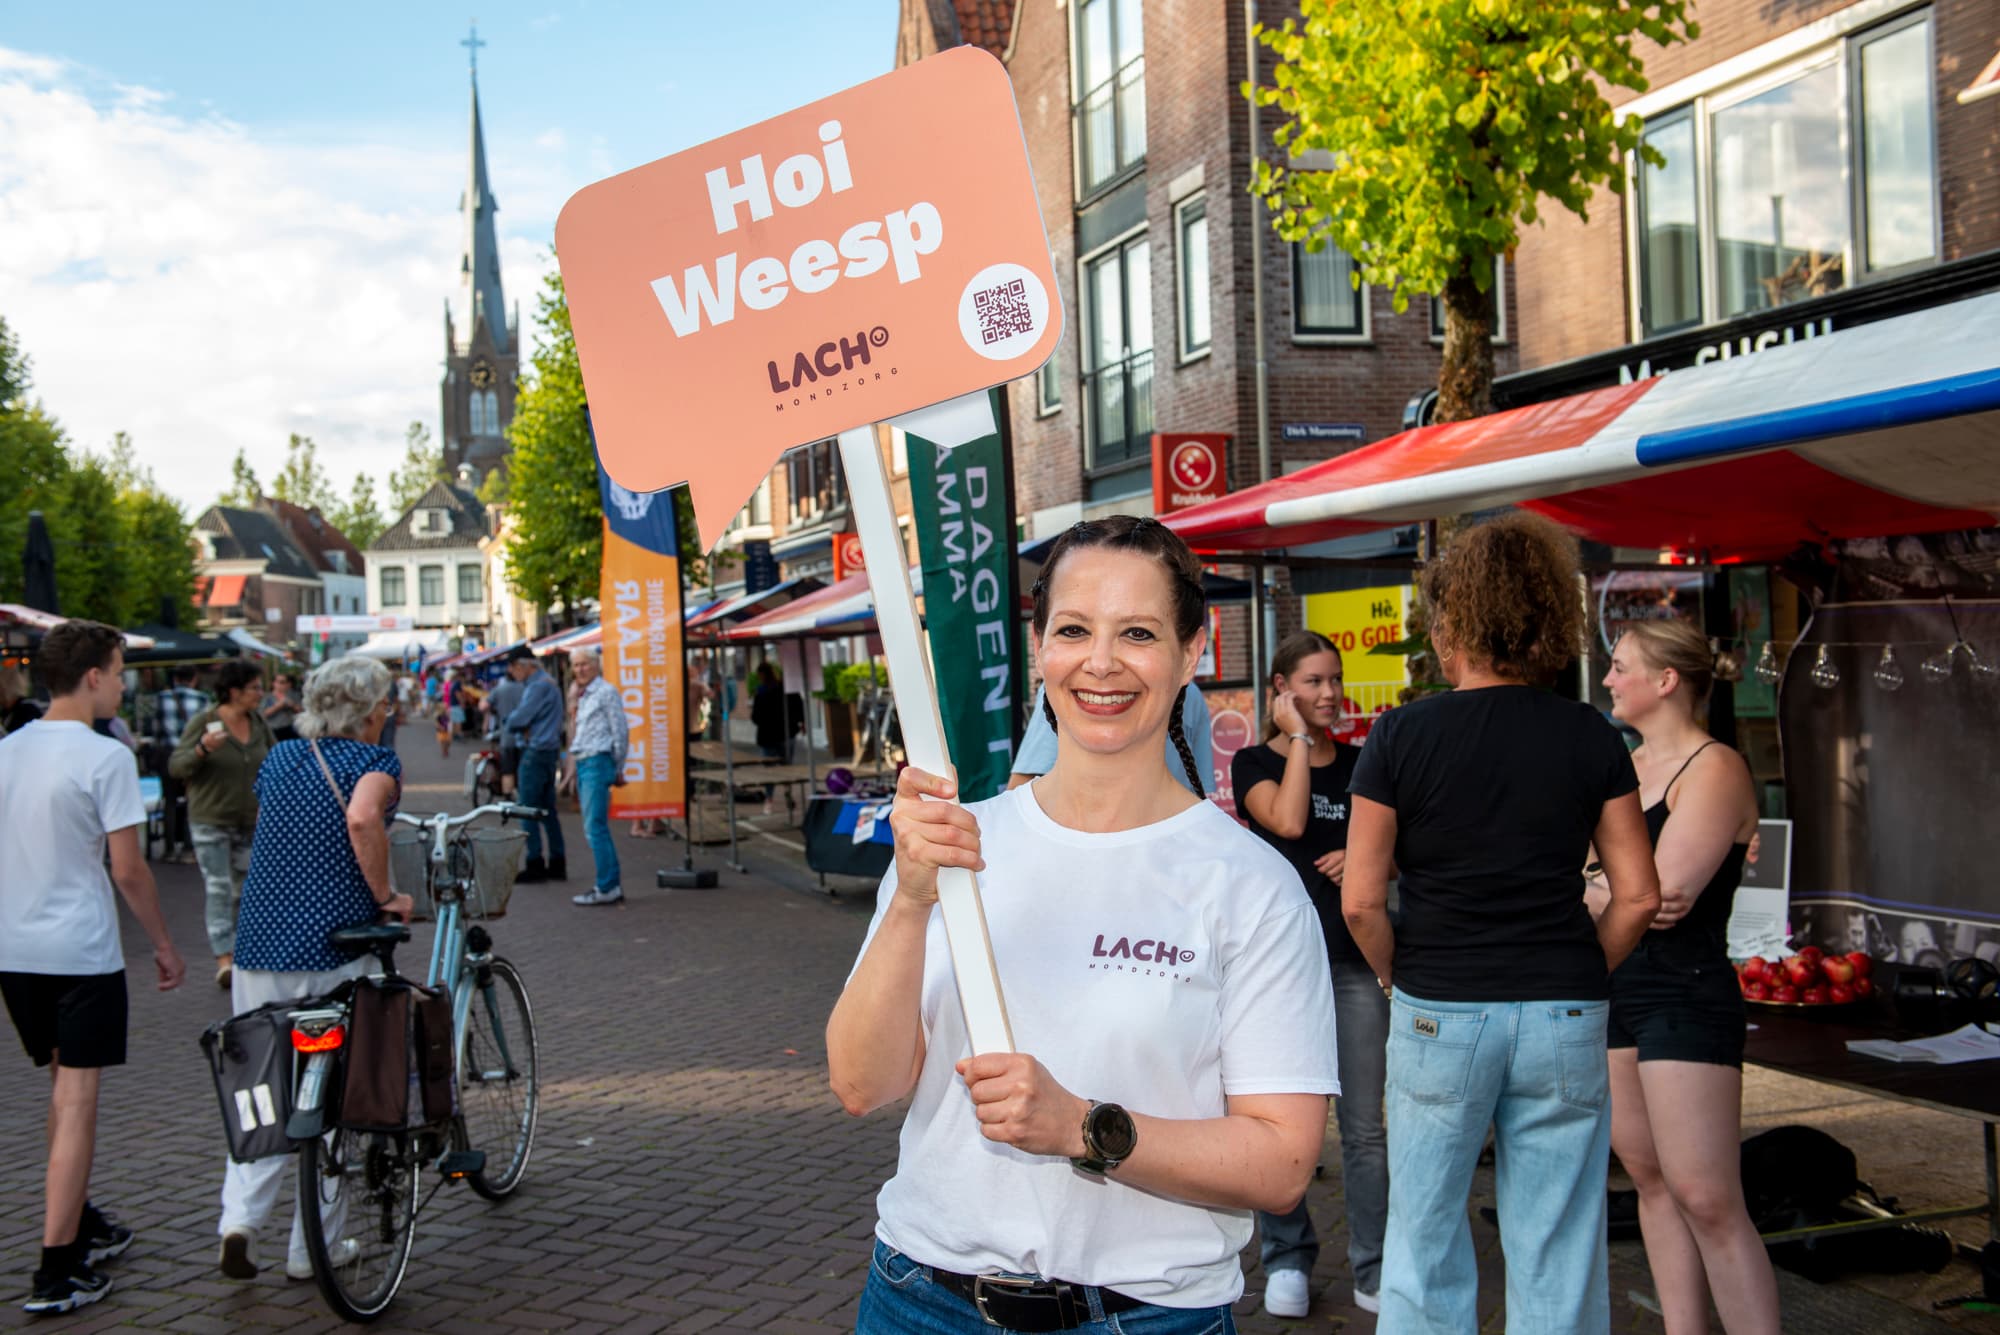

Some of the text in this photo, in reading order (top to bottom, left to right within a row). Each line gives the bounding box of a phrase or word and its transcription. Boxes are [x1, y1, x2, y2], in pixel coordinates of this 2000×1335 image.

[705, 120, 854, 234] Hoi
[651, 201, 943, 338] Weesp
[775, 367, 900, 413] MONDZORG
[965, 466, 1012, 713] DAGEN
[1371, 599, 1398, 619] Hè,
[1329, 630, 1356, 652] ZO
[1314, 809, 1346, 821] SHAPE
[1089, 963, 1191, 983] MONDZORG
[1415, 1018, 1435, 1034] Lois
